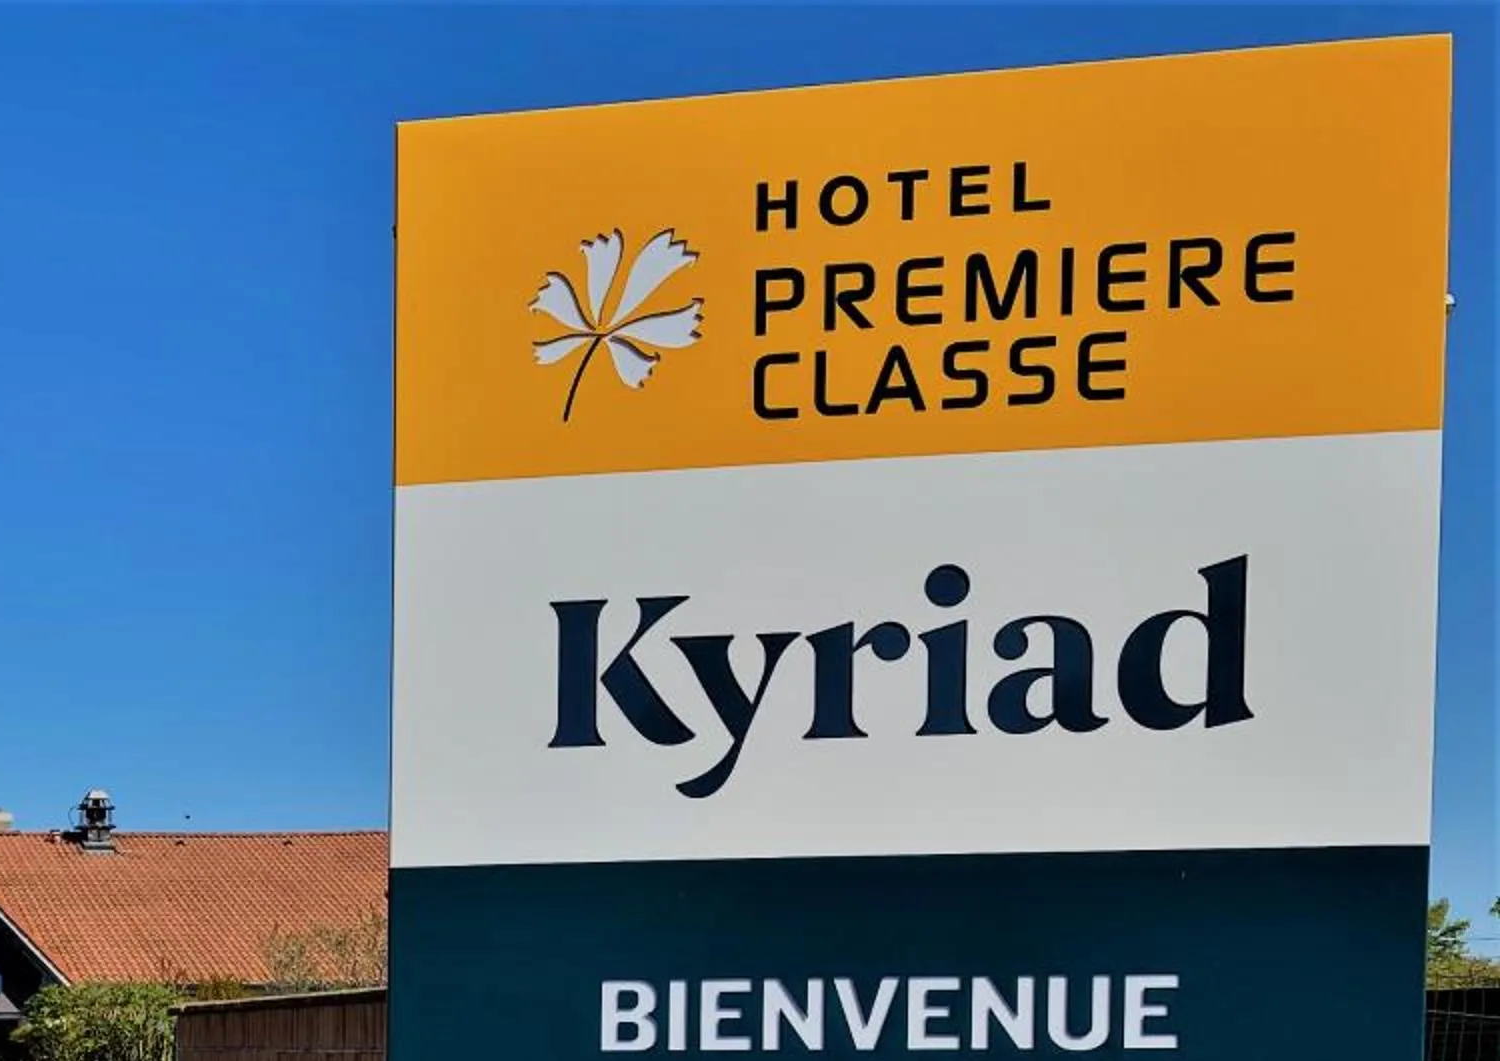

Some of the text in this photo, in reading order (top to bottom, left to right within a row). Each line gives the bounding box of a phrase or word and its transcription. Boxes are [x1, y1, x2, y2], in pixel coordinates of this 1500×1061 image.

[756, 162, 1050, 231] HOTEL
[754, 231, 1295, 336] PREMIERE
[753, 331, 1127, 420] CLASSE
[548, 554, 1255, 799] Kyriad
[600, 974, 1179, 1052] BIENVENUE
